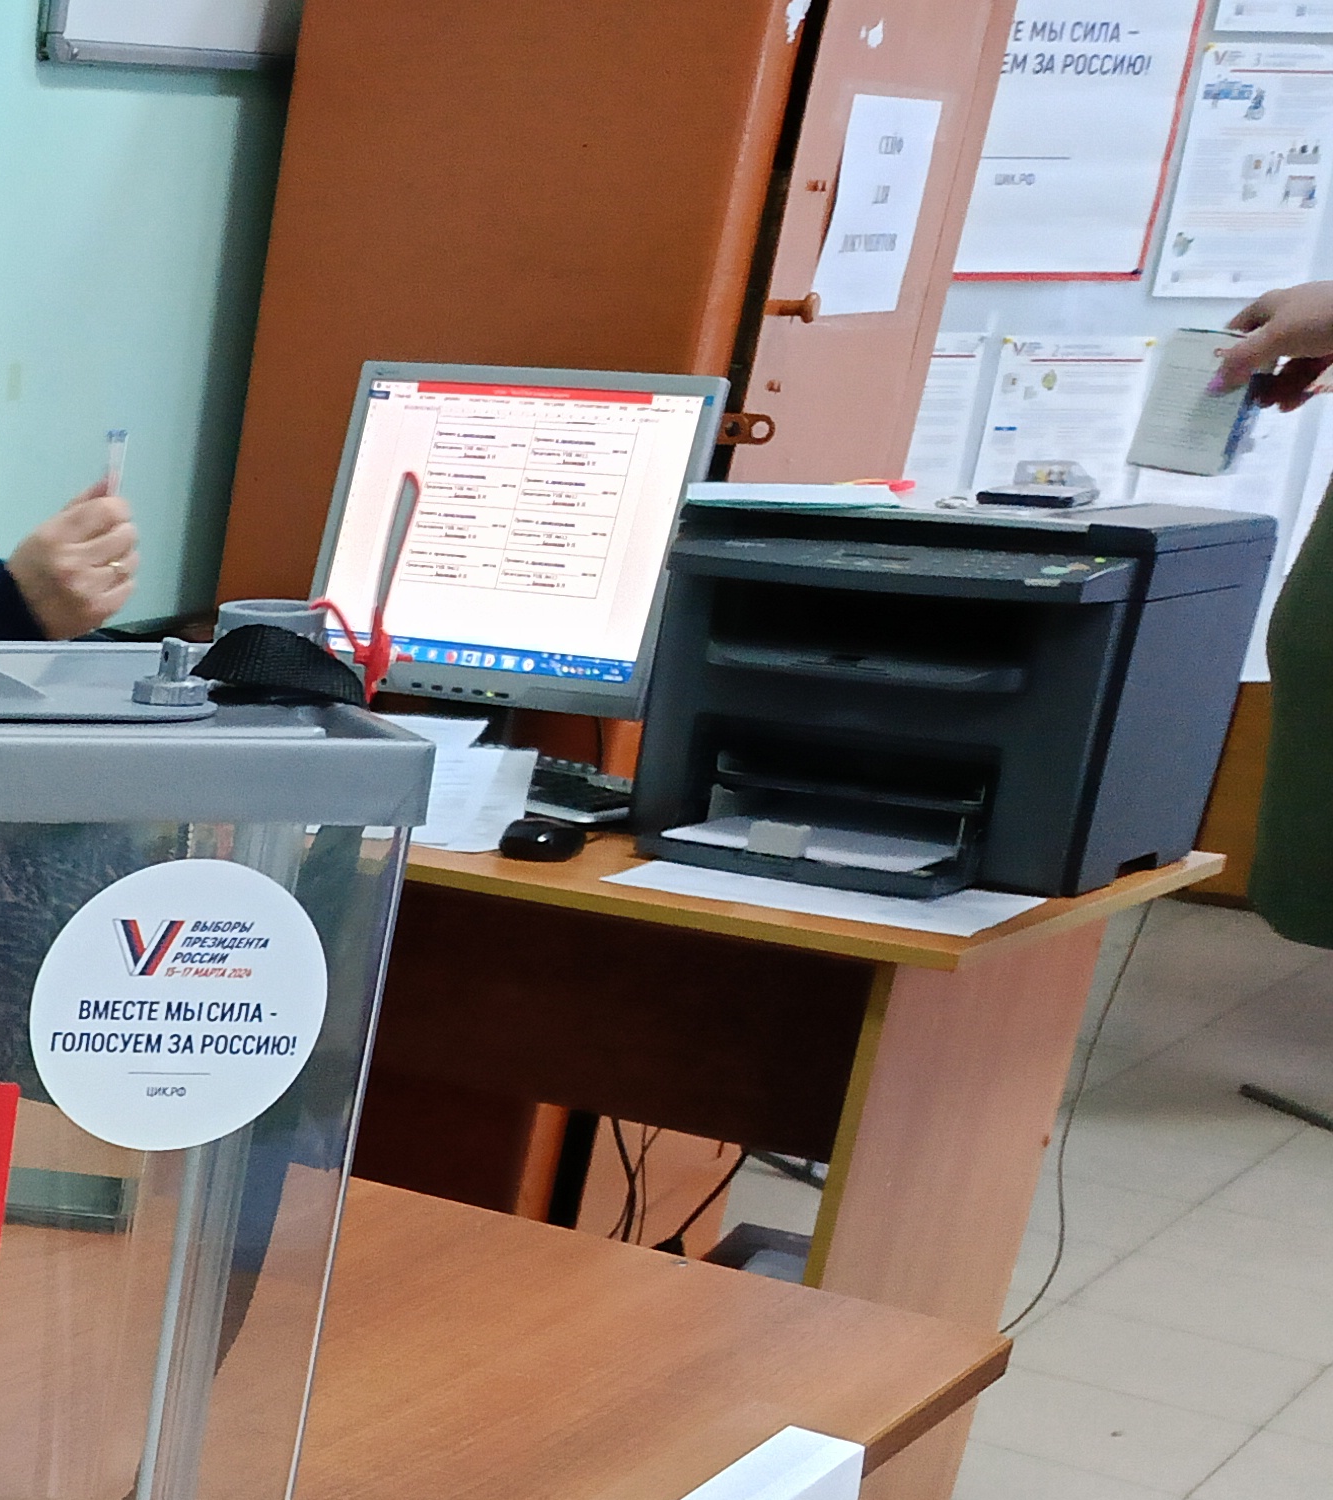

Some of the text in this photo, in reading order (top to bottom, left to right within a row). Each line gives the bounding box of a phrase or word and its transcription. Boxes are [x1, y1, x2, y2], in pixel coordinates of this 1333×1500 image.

[1029, 21, 1066, 42] МЫ
[1070, 21, 1121, 42] СИЛА
[1033, 52, 1055, 75] ЗА
[1060, 53, 1152, 76] РОССИЮ!
[190, 920, 255, 933] ВЫБОРЫ
[181, 936, 271, 950] ПРЕЗИДЕНТА
[171, 952, 230, 964] РОССИИ
[193, 968, 227, 978] МАРТА
[227, 968, 253, 979] 2024
[78, 1000, 160, 1021] ВМЕСТЕ
[164, 1001, 203, 1022] МЫ
[206, 1003, 263, 1023] СИЛА
[50, 1032, 298, 1057] ГОЛОСУЕМ ЗА РОССИЮ!
[145, 1085, 187, 1098] ЦИК.РФ
